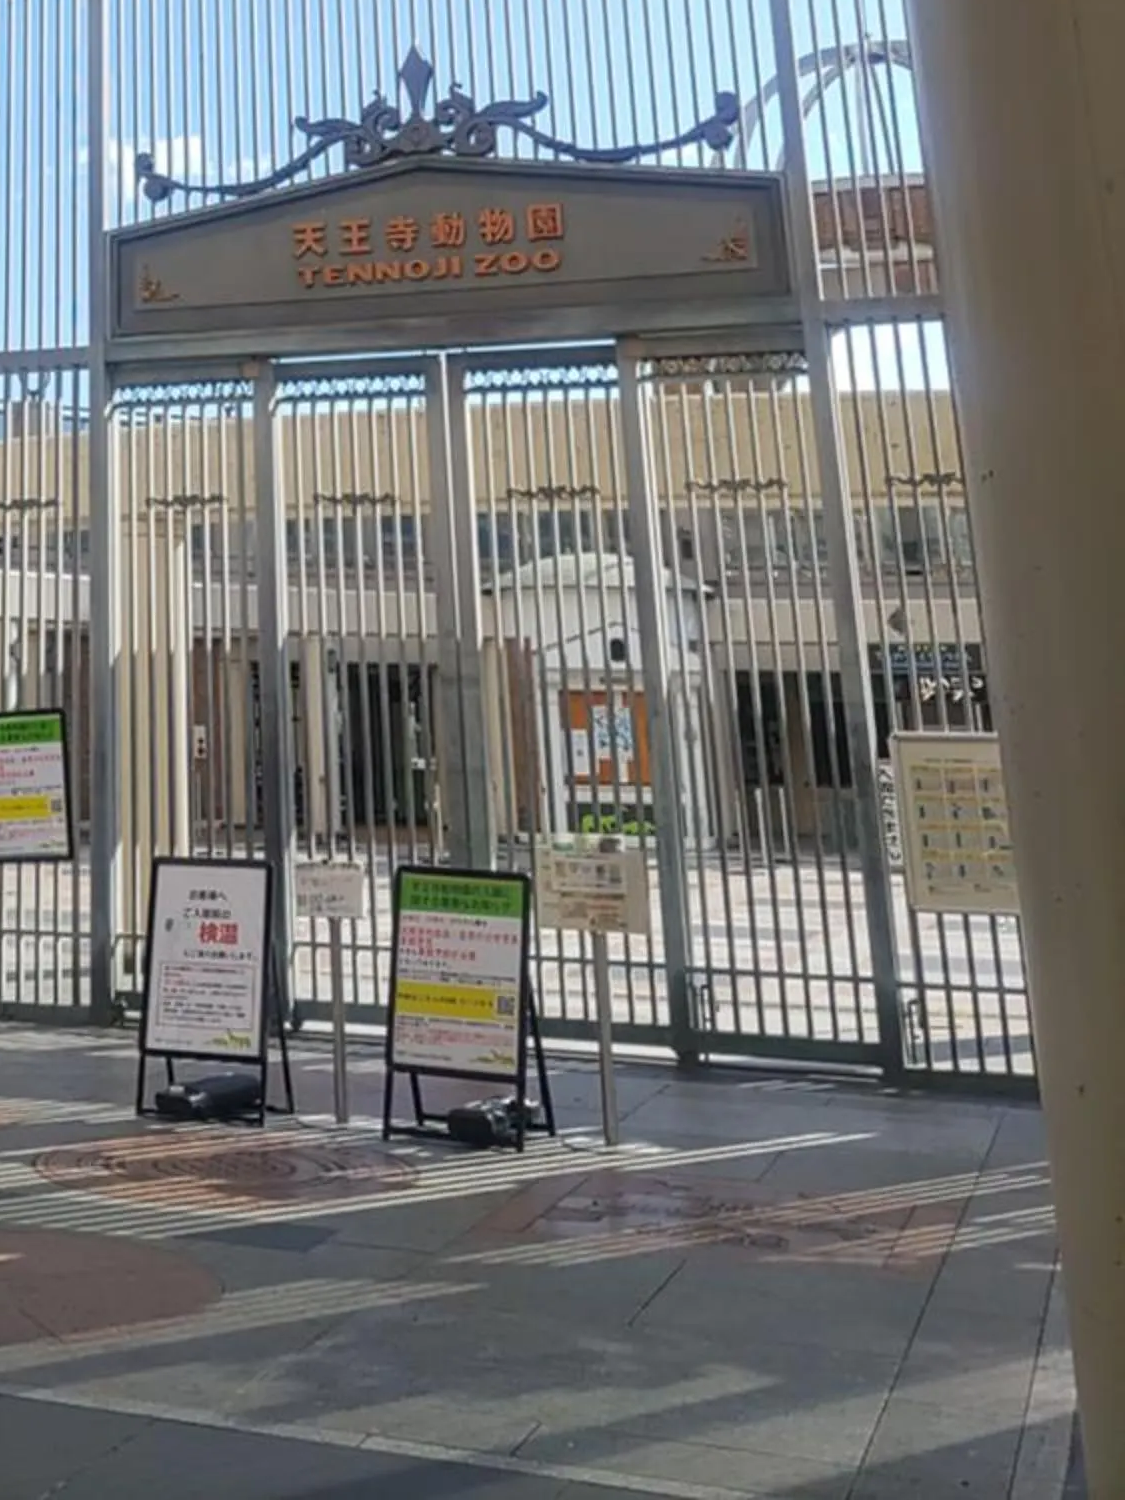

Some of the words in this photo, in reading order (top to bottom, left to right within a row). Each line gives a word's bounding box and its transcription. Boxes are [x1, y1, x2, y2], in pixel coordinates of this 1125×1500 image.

[292, 203, 565, 259] 天王寺動物園
[297, 255, 463, 288] TENNOJI
[475, 247, 561, 277] ZOO
